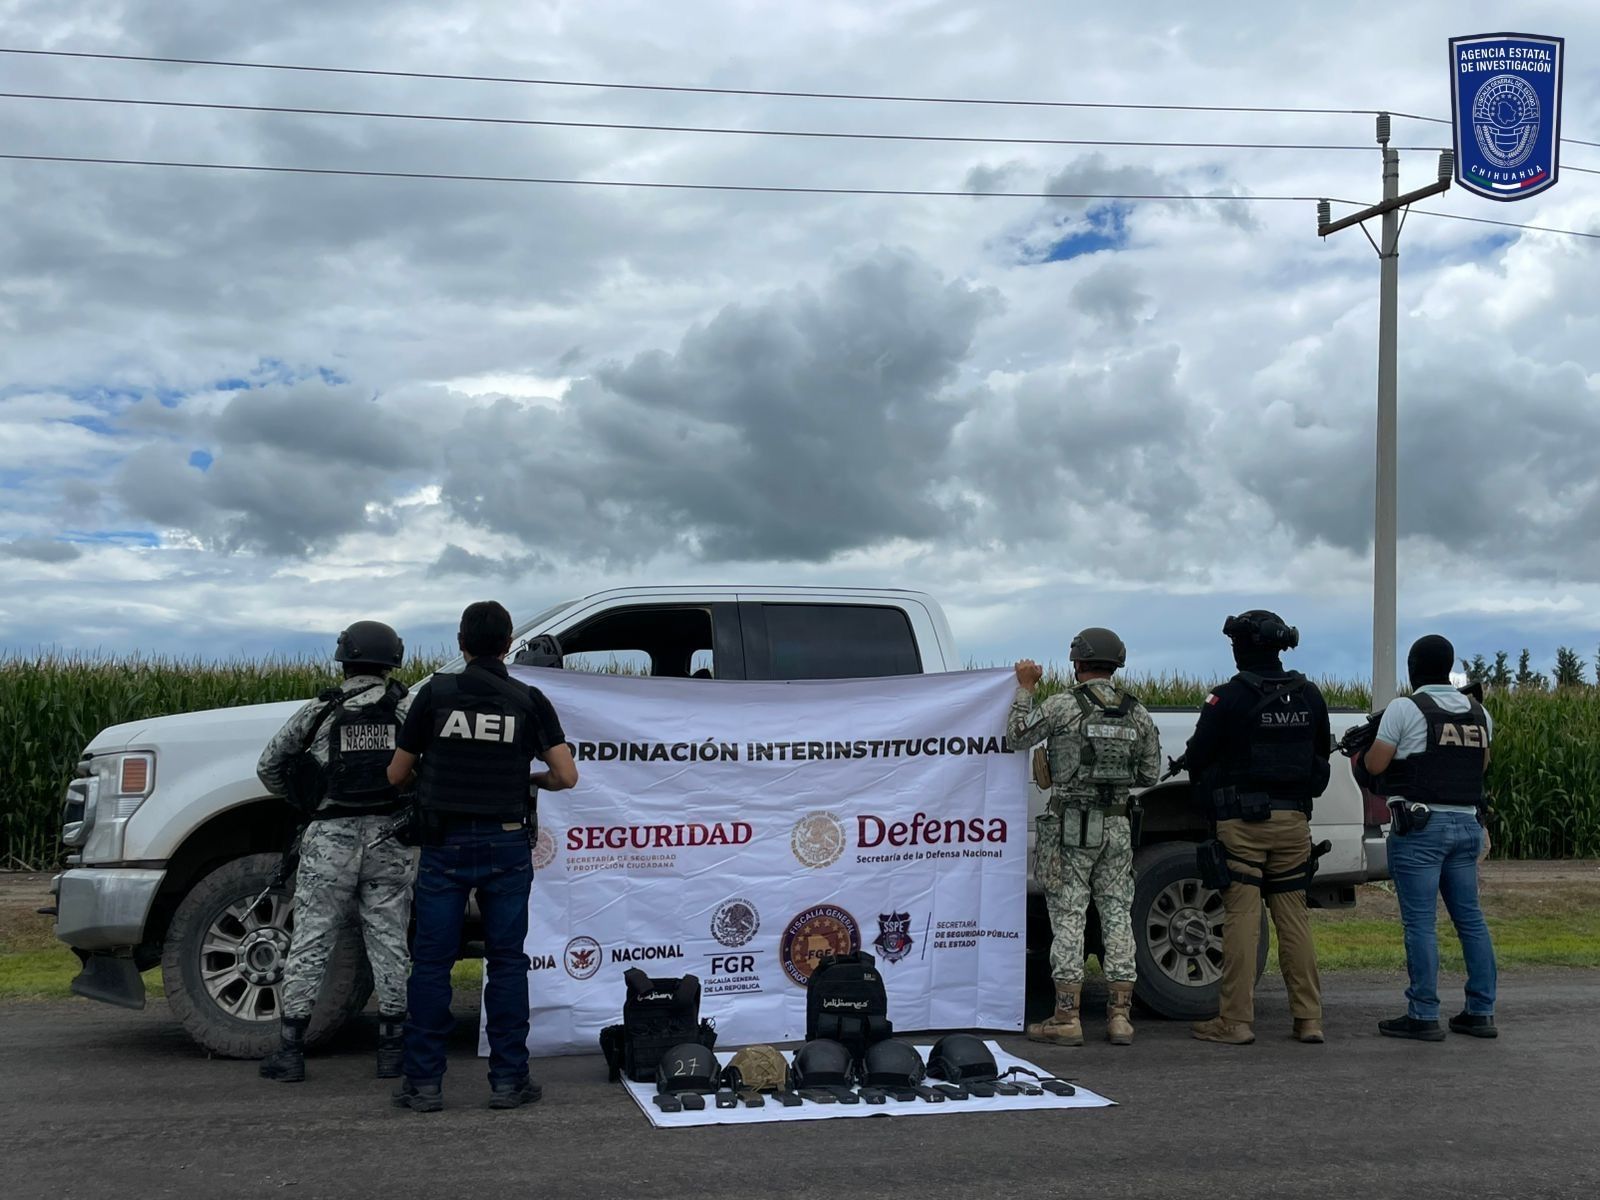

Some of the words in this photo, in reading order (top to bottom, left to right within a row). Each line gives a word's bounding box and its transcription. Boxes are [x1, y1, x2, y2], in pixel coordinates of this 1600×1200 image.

[1261, 711, 1308, 723] SWAT
[346, 726, 389, 738] GUARDIA
[439, 710, 515, 743] AEI
[1439, 723, 1488, 748] AEI
[346, 737, 390, 750] NACIONAL
[747, 736, 1014, 761] INTERINSTITUCIONAL
[566, 822, 753, 850] SEGURIDAD
[857, 812, 1007, 848] Defensa
[857, 853, 901, 863] Secretaría
[903, 851, 914, 861] de
[915, 851, 924, 860] la
[926, 850, 960, 860] Defensa
[962, 849, 1003, 859] Nacional
[826, 908, 855, 935] GENERAL
[883, 921, 904, 933] SSPE
[936, 919, 977, 929] SECRETARÍA
[935, 931, 946, 939] DE
[946, 929, 986, 939] SEGURIDAD
[986, 929, 1019, 939] PÚBLICA
[949, 940, 976, 948] ESTADO
[612, 944, 683, 963] NACIONAL
[711, 955, 755, 975] FGR
[784, 960, 808, 984] ESTADO
[732, 975, 760, 983] GENERAL
[674, 1058, 699, 1076] 27
